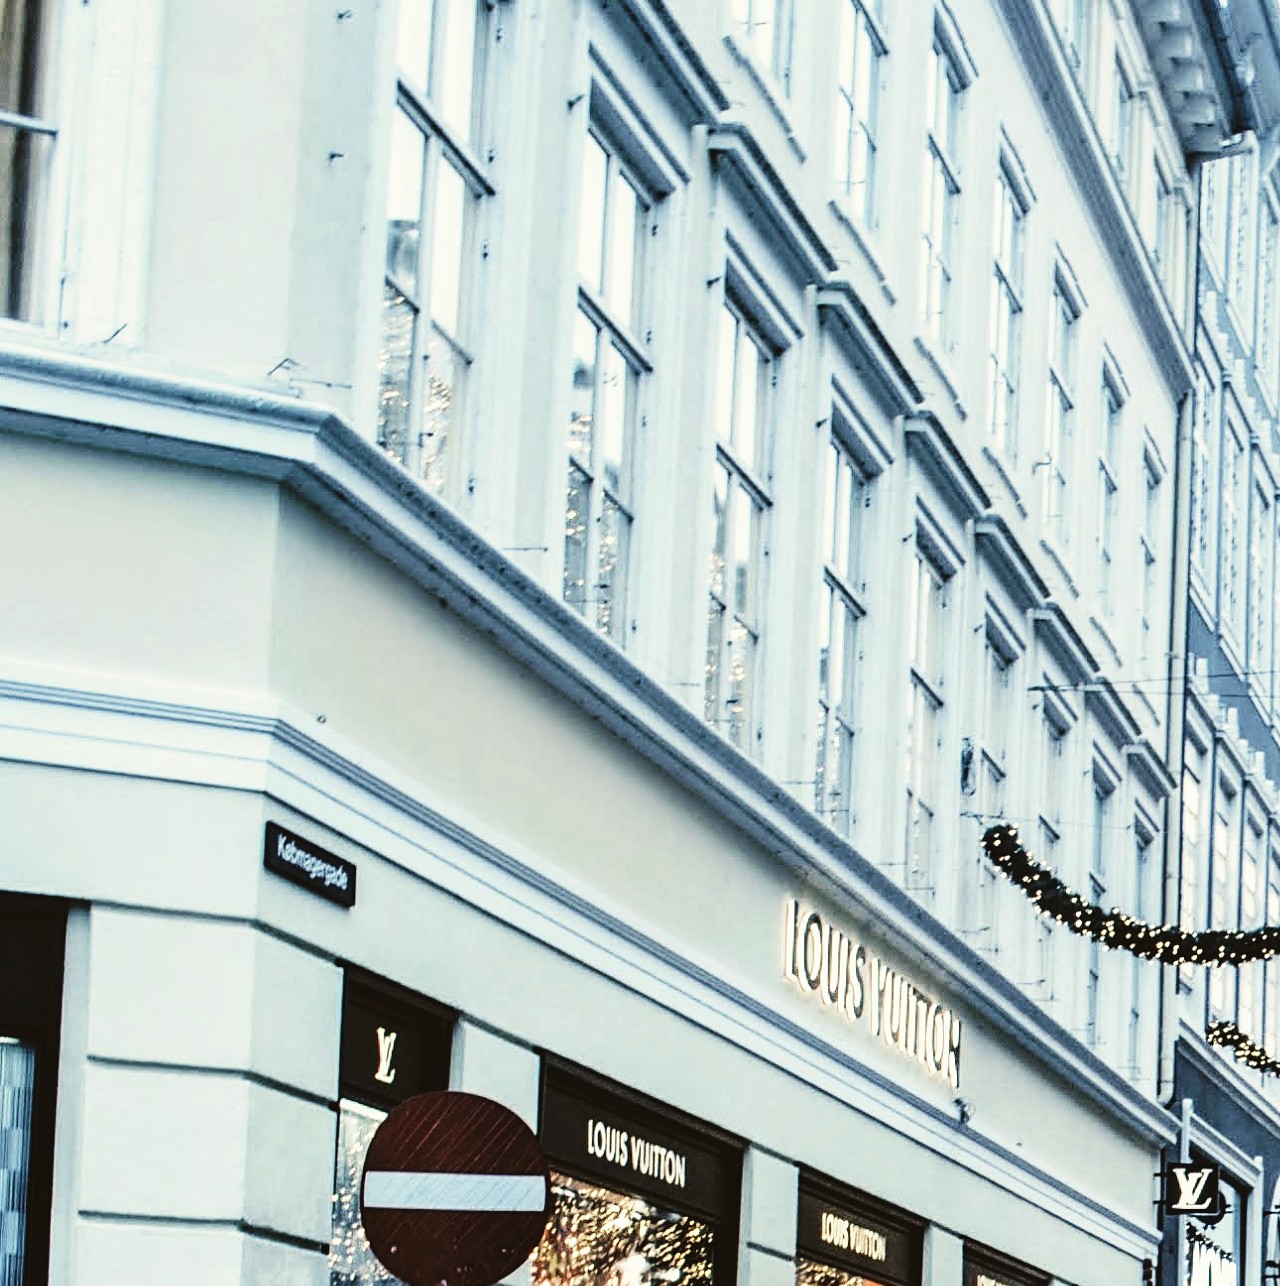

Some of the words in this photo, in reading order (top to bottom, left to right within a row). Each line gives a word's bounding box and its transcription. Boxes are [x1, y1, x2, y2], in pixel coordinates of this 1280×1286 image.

[784, 899, 866, 1022] LOUIS
[868, 957, 961, 1089] VUITTON
[587, 1119, 628, 1167] LOUIS
[631, 1136, 686, 1188] VUITTON
[1171, 1168, 1213, 1209] LV
[820, 1212, 849, 1249] LOUIS
[849, 1224, 886, 1262] VUITTON
